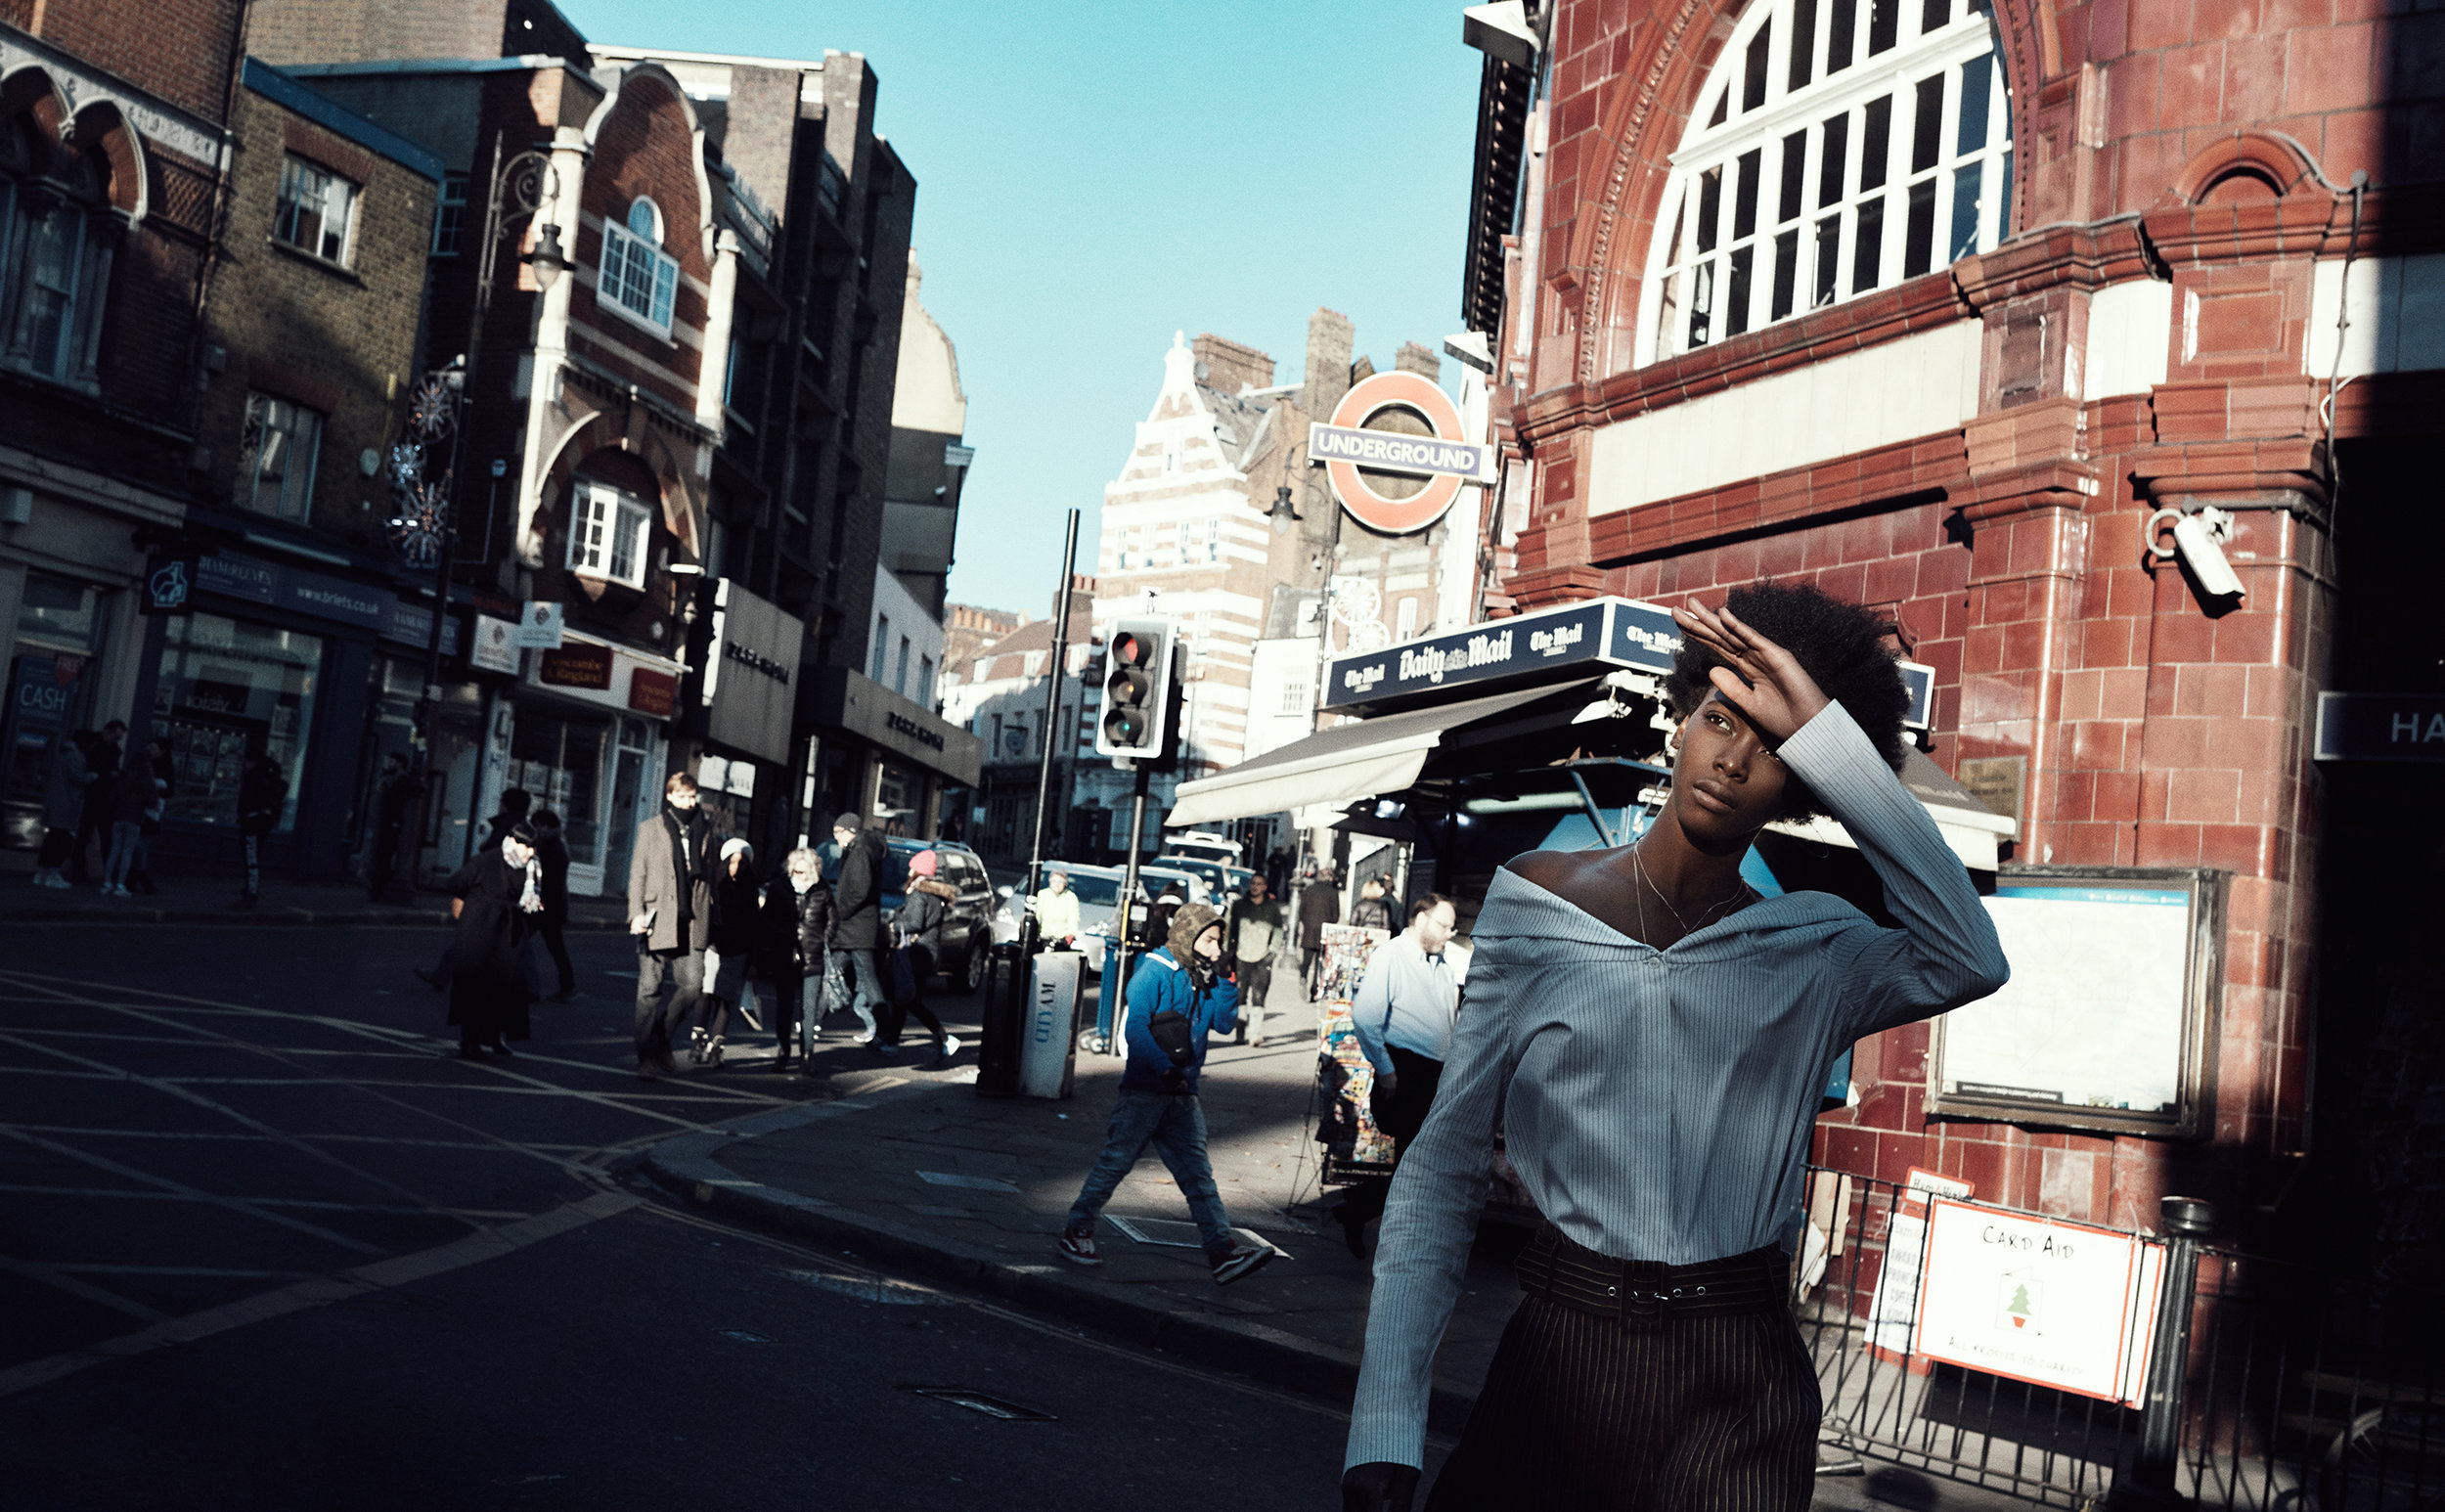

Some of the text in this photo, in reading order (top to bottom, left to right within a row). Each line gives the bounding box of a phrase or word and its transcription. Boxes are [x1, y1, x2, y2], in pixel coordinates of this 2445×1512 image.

[1318, 432, 1476, 469] UNDERGROUND
[1530, 630, 1554, 651] The
[1554, 623, 1582, 644] Mail
[1627, 625, 1655, 646] The
[1399, 630, 1513, 683] Daily Mail
[20, 683, 67, 711] CASH
[1981, 1224, 2075, 1260] CARD AID
